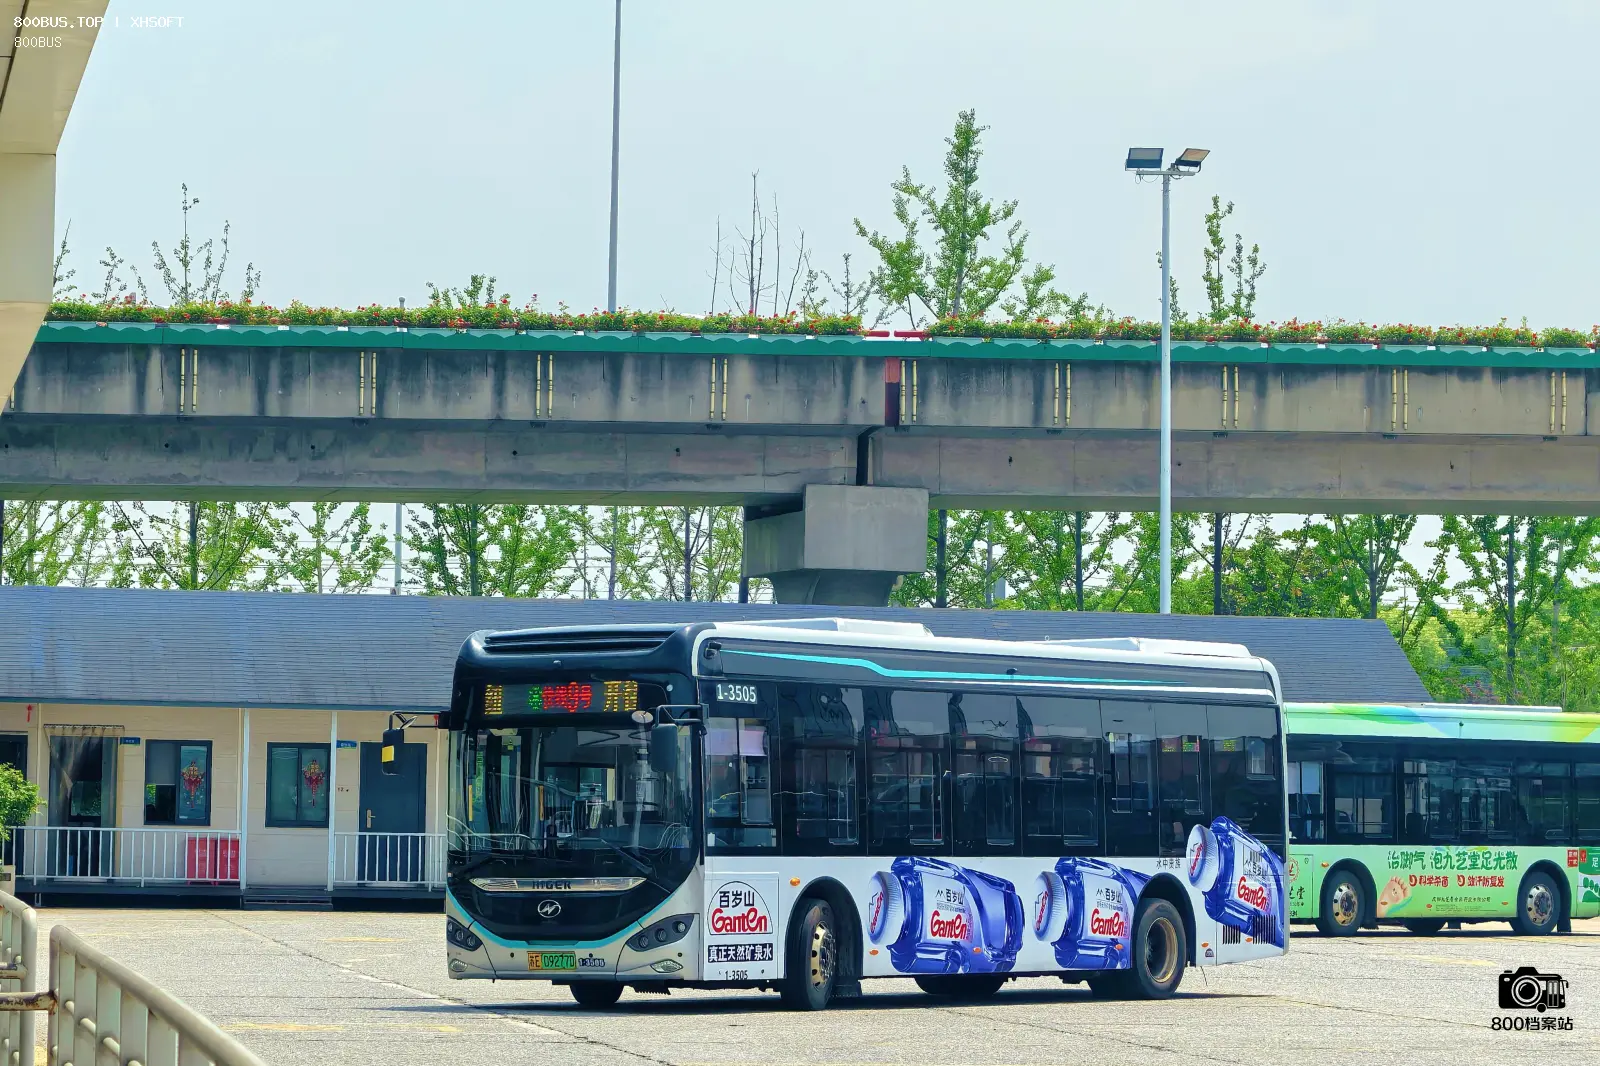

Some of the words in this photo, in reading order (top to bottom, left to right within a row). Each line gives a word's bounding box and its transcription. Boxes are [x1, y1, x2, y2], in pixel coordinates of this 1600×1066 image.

[716, 683, 757, 703] 1-3505
[1387, 851, 1426, 870] 治脚气
[1430, 850, 1518, 870] 泡九芝堂足光散
[719, 890, 755, 908] 百岁山
[945, 888, 964, 905] 百岁山
[1237, 876, 1267, 911] Ganten
[711, 907, 768, 933] Ganten
[930, 910, 967, 940] Ganten
[1091, 908, 1124, 937] Ganten
[708, 943, 772, 962] 真正天然矿泉水
[725, 969, 749, 980] 1-3505
